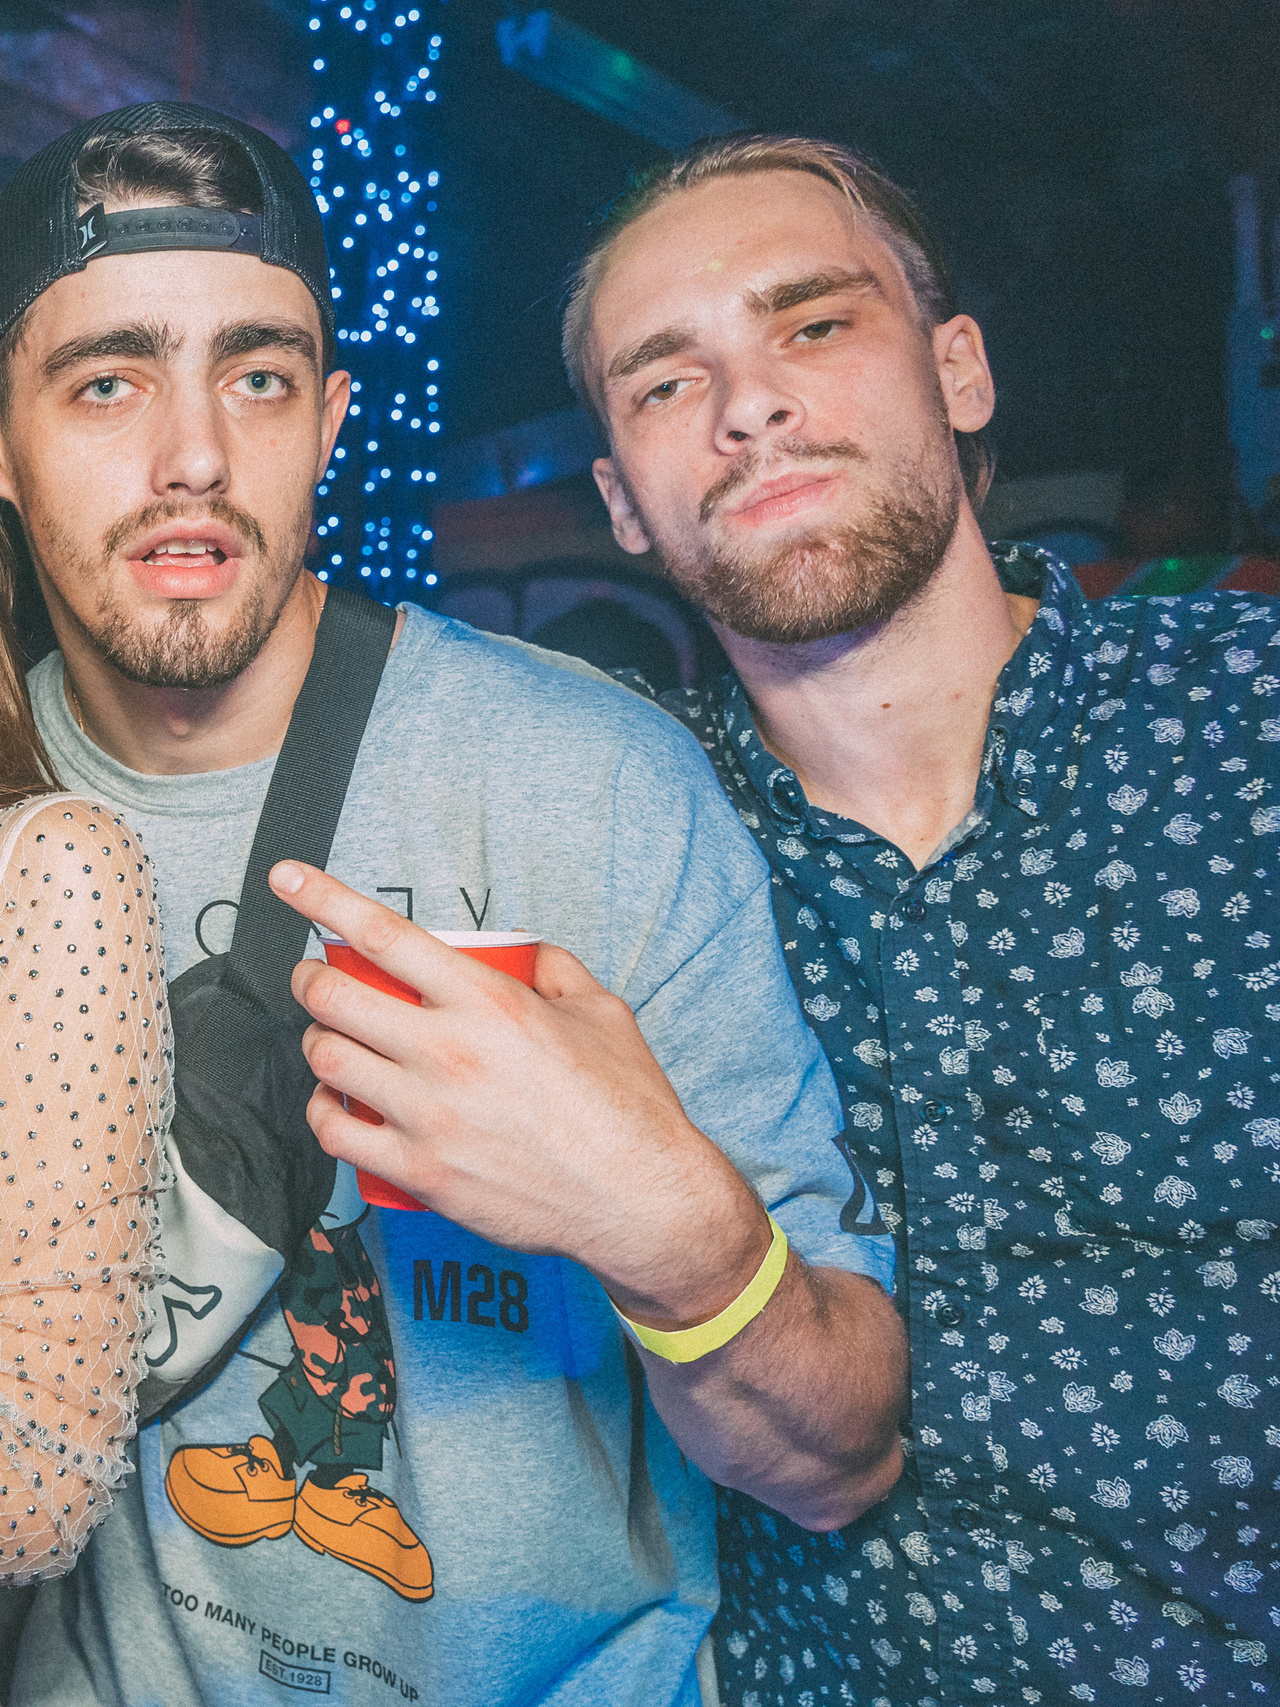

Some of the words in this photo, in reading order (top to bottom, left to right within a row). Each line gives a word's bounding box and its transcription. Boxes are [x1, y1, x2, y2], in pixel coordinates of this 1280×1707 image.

[413, 1259, 529, 1333] M28
[162, 1582, 199, 1612] TOO
[204, 1601, 257, 1635] MANY
[261, 1626, 336, 1663] PEOPLE
[343, 1651, 400, 1688] GROW
[400, 1678, 419, 1703] UP
[265, 1659, 289, 1680] EST.
[290, 1671, 323, 1687] 1928
